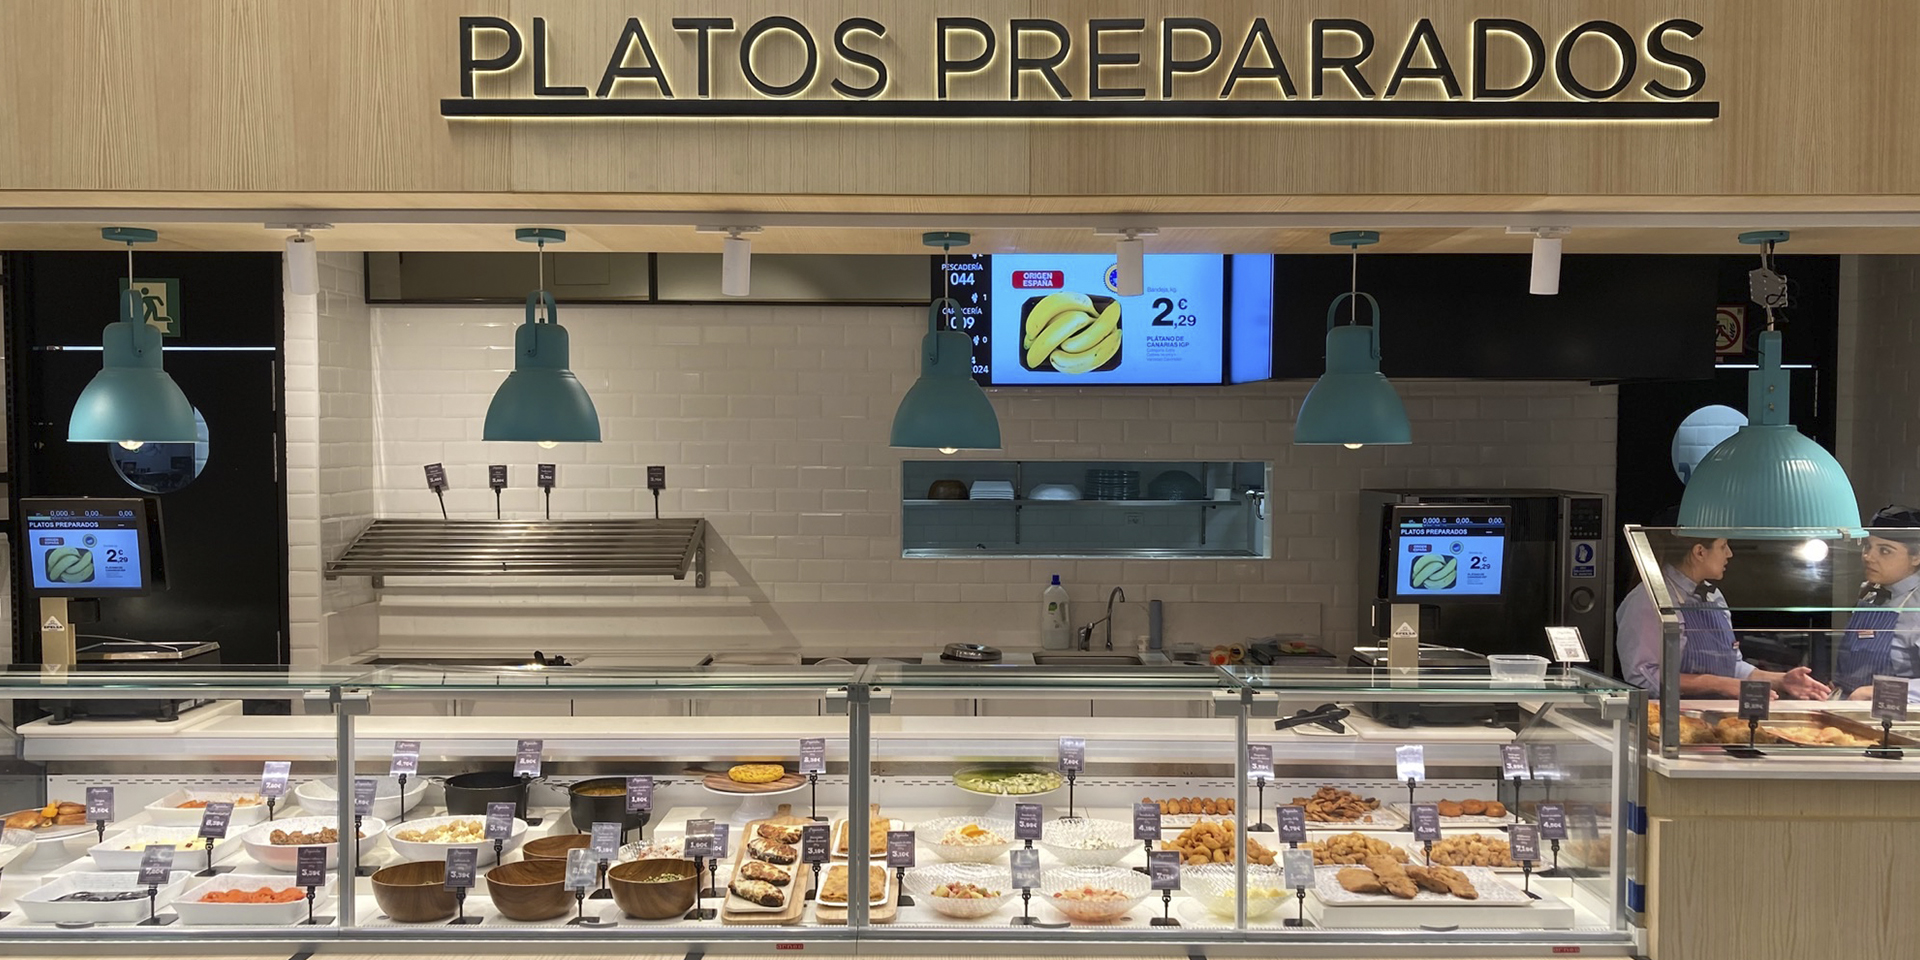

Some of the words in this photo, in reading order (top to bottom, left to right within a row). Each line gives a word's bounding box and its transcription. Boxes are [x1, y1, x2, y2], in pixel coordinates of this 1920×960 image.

[459, 15, 889, 98] PLATOS
[936, 16, 1707, 100] PREPARADOS
[950, 273, 975, 285] 044
[950, 317, 975, 329] 09
